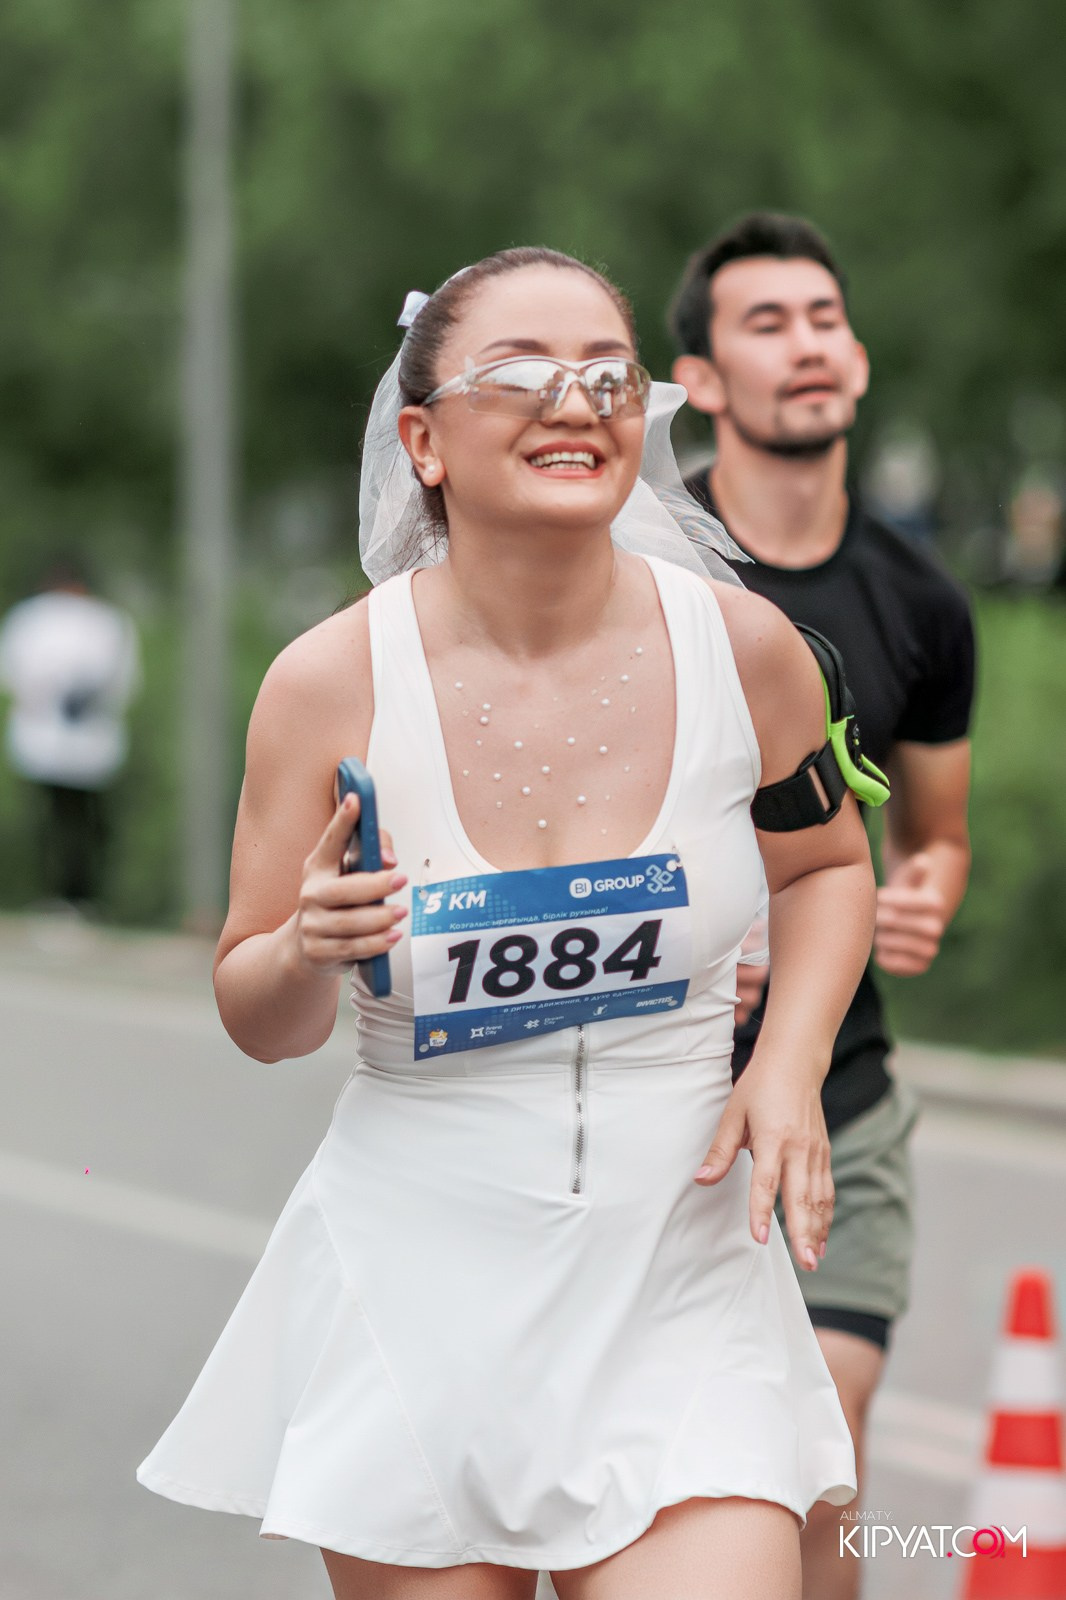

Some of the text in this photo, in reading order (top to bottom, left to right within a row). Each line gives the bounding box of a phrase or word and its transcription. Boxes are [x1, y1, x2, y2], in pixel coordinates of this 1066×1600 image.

[574, 882, 587, 894] BI
[593, 874, 645, 893] GROUP
[422, 891, 444, 915] 5
[448, 919, 663, 1005] 1884
[635, 996, 674, 1008] INVICTUS
